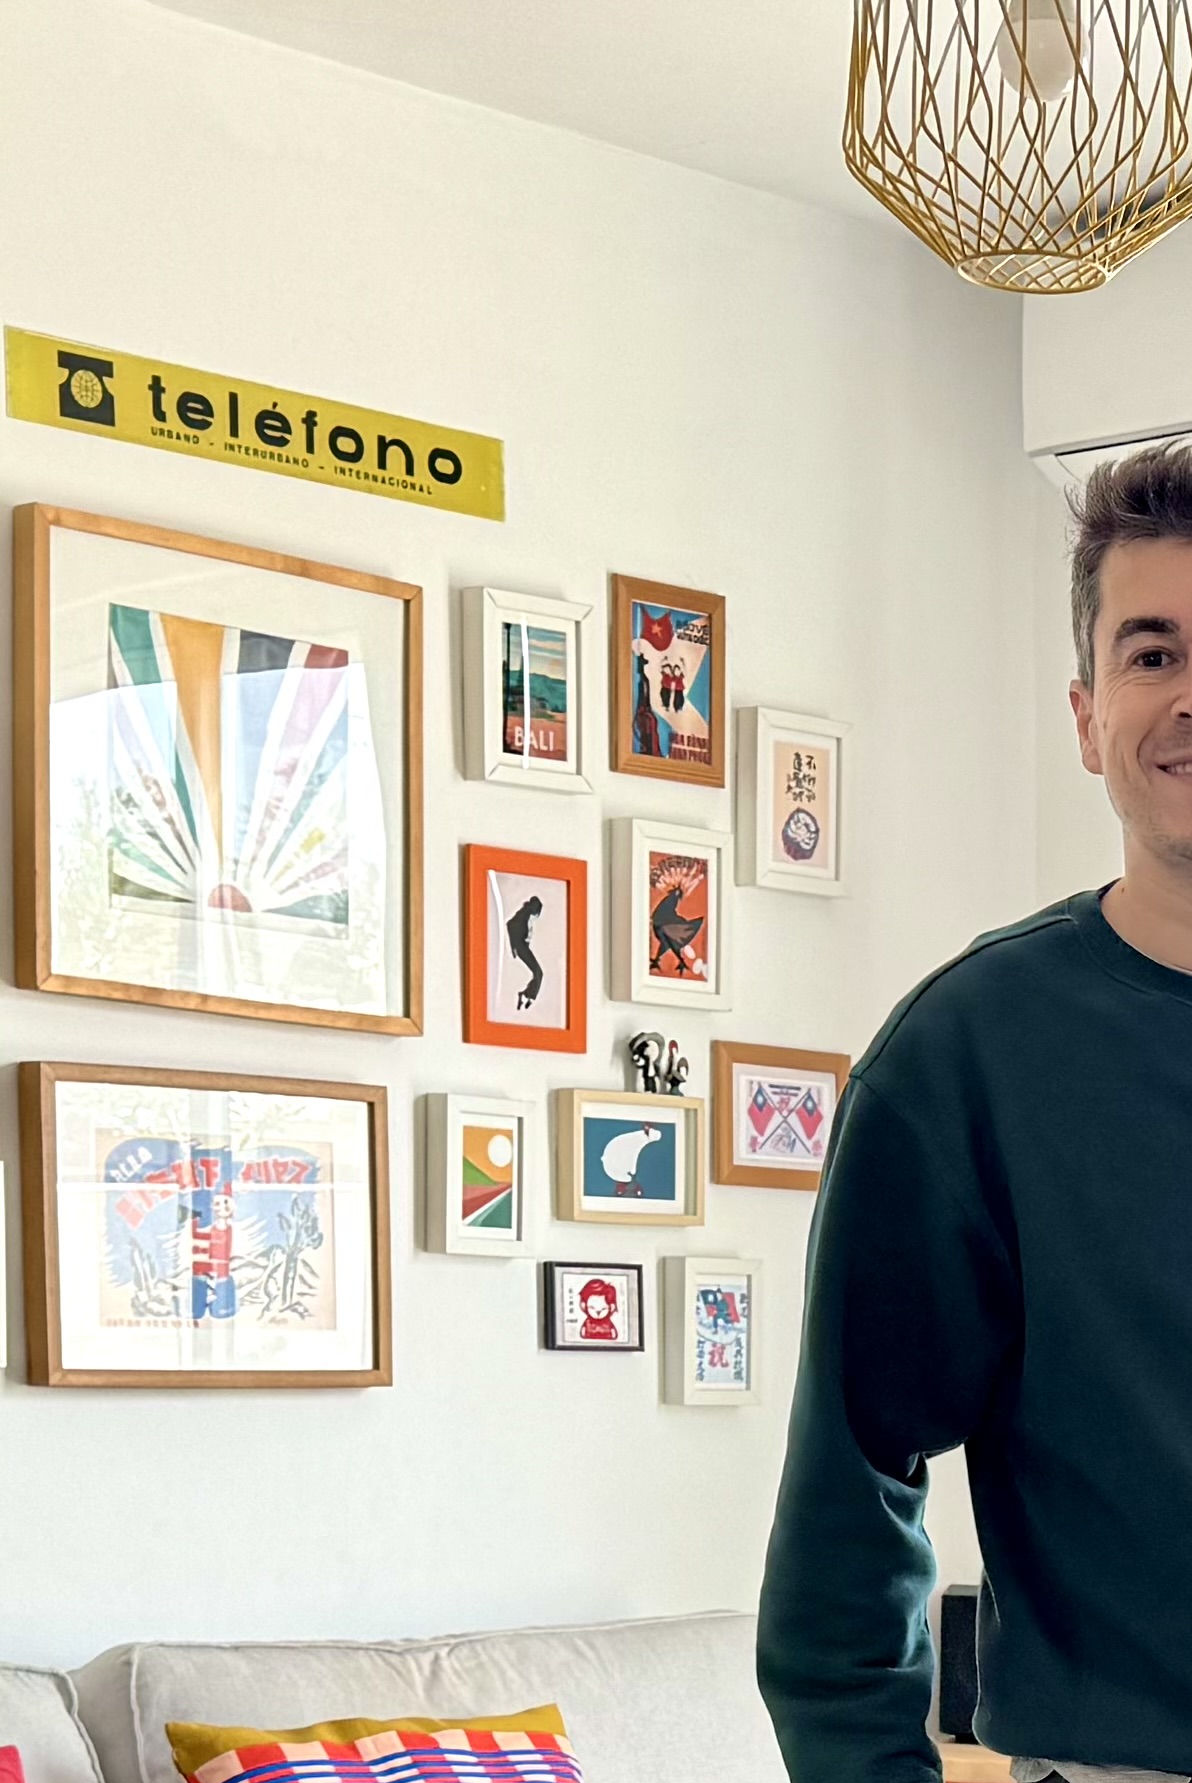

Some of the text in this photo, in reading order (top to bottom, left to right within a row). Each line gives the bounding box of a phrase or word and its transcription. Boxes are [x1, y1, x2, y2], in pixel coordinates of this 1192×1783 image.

[148, 374, 463, 485] teléfono
[150, 426, 200, 445] URBANO
[224, 442, 309, 468] INTERURBANO
[334, 465, 433, 495] INTERNACIONAL
[514, 726, 554, 751] BALI
